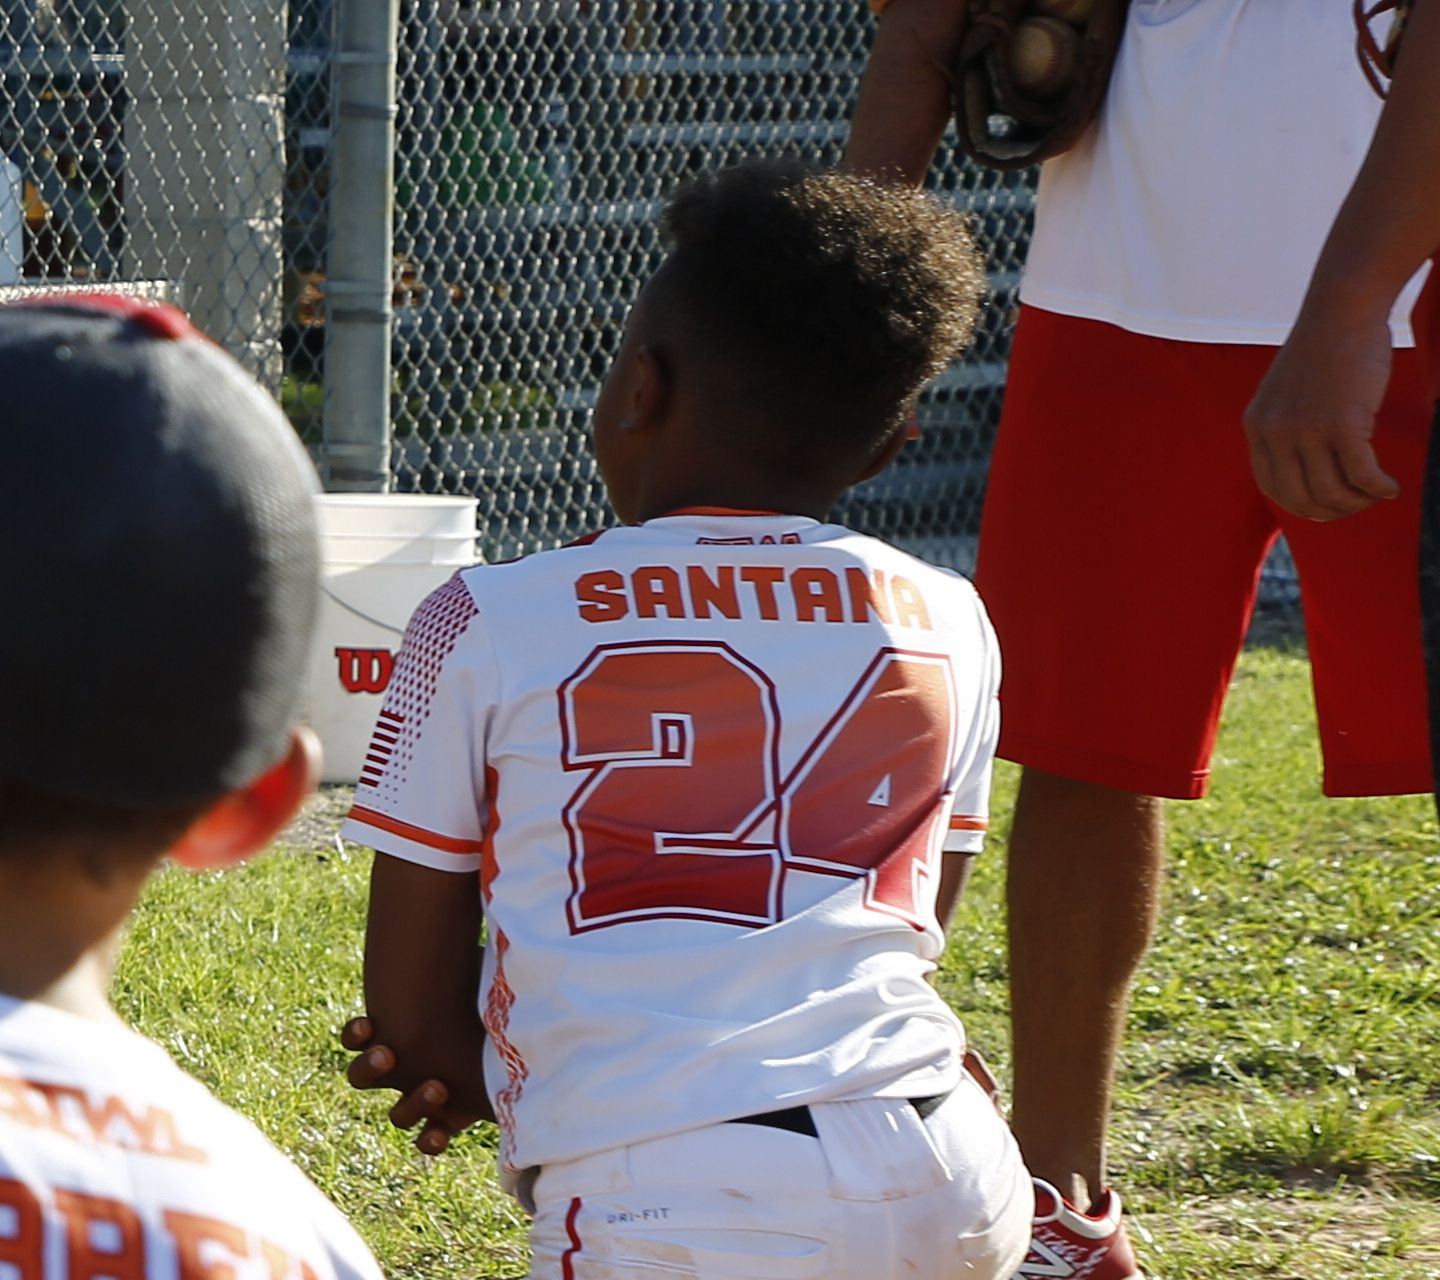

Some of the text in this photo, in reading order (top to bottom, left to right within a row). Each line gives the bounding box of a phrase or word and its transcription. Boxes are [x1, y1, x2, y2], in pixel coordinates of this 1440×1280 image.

[574, 564, 934, 631] SANTANA
[558, 639, 960, 937] 24
[606, 1207, 670, 1224] DRI-FIT
